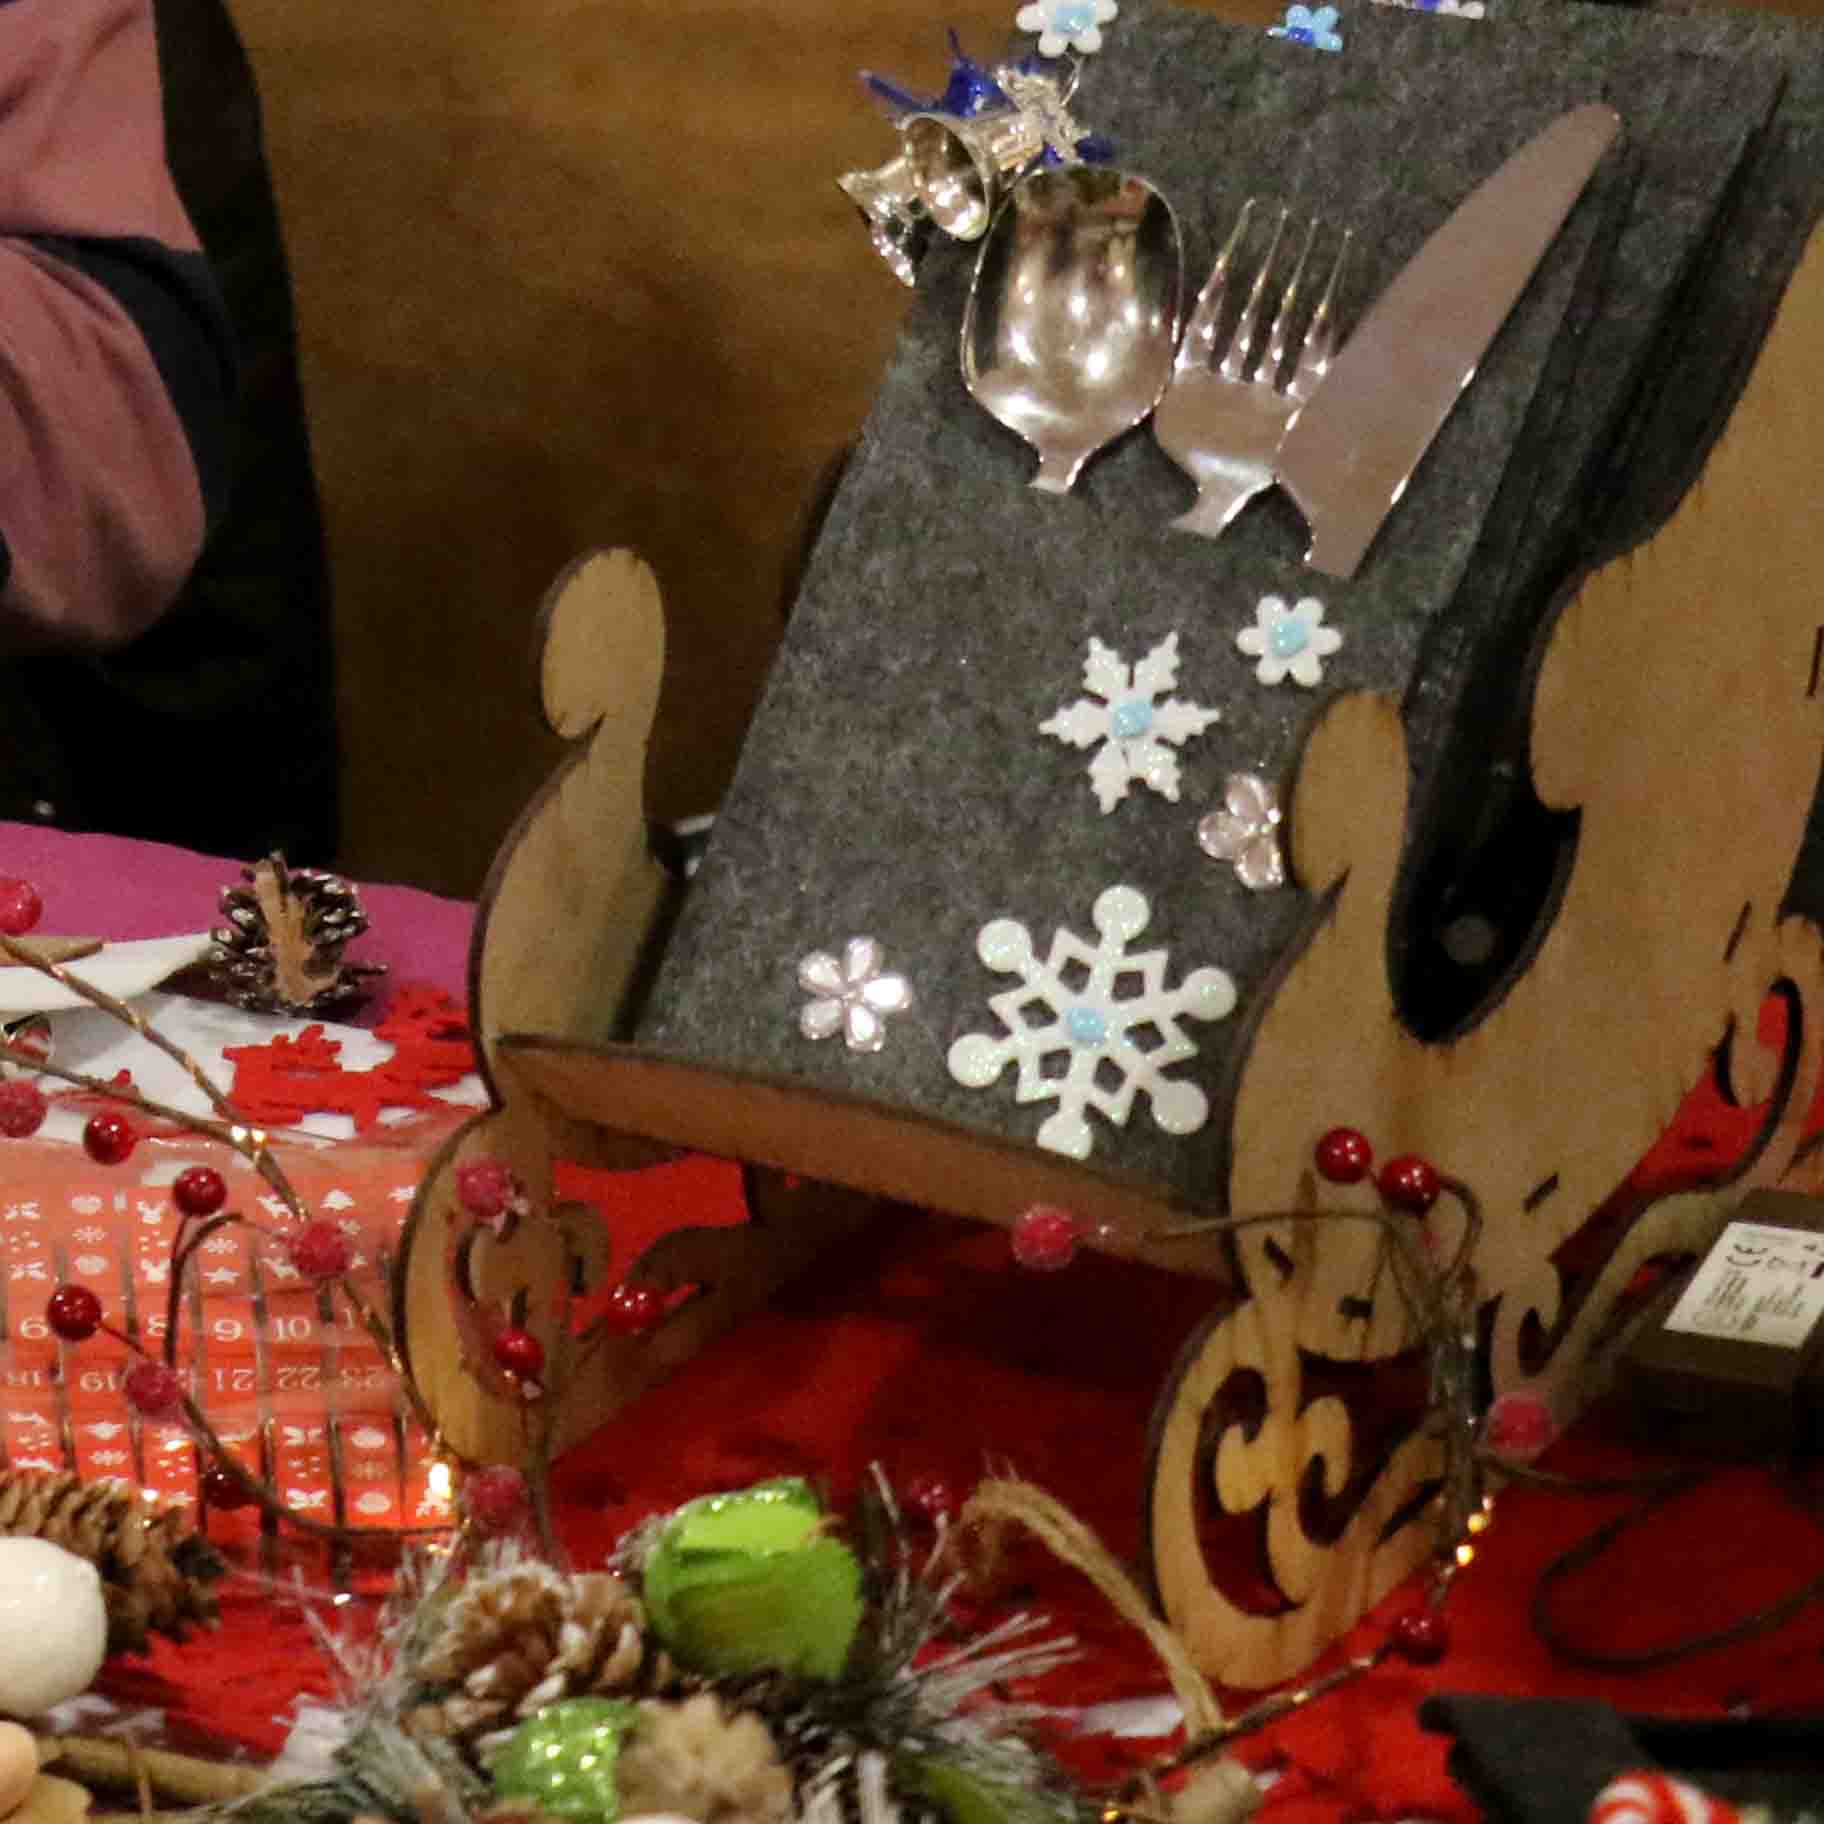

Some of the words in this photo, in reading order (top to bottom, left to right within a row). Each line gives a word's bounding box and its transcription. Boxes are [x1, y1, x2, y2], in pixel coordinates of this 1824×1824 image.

[18, 1319, 50, 1342] 6
[213, 1319, 244, 1343] 9
[271, 1317, 313, 1342] 10
[213, 1368, 253, 1393] 21
